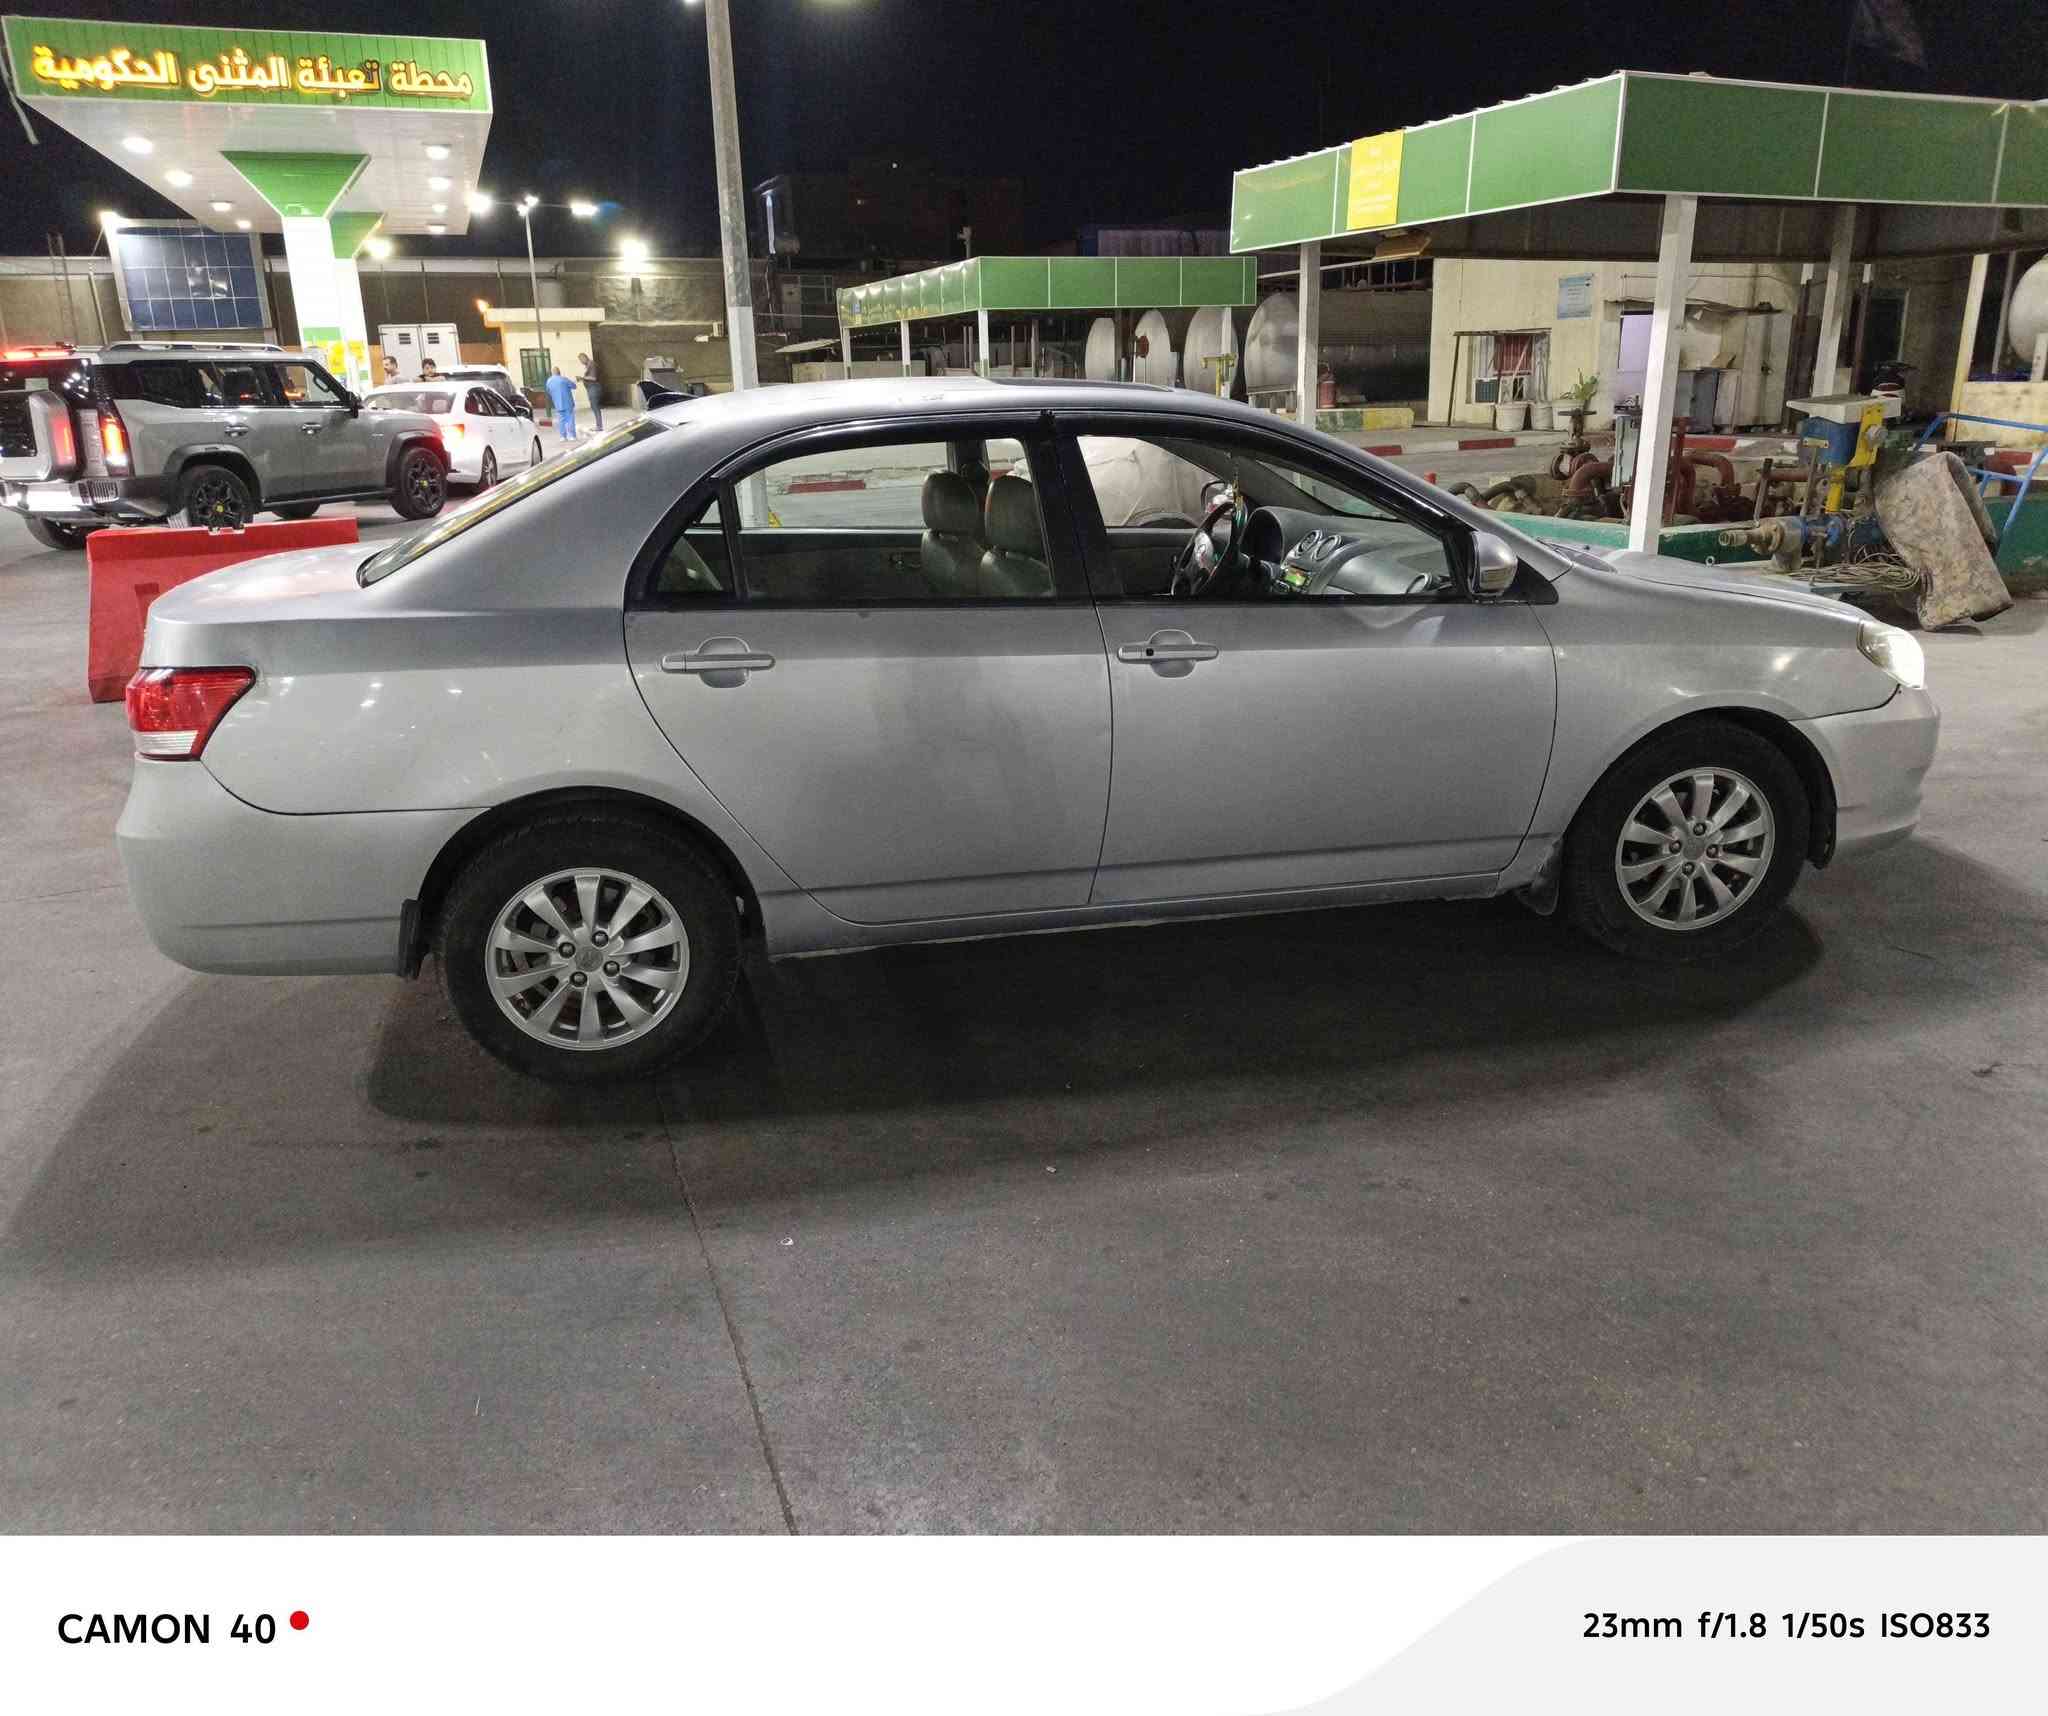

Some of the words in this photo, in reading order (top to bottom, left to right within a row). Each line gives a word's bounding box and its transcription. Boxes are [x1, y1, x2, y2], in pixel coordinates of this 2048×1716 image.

[33, 45, 180, 90] الحكومية
[189, 47, 290, 96] المثنى
[297, 54, 382, 99] تعبئة
[390, 59, 473, 98] محطة
